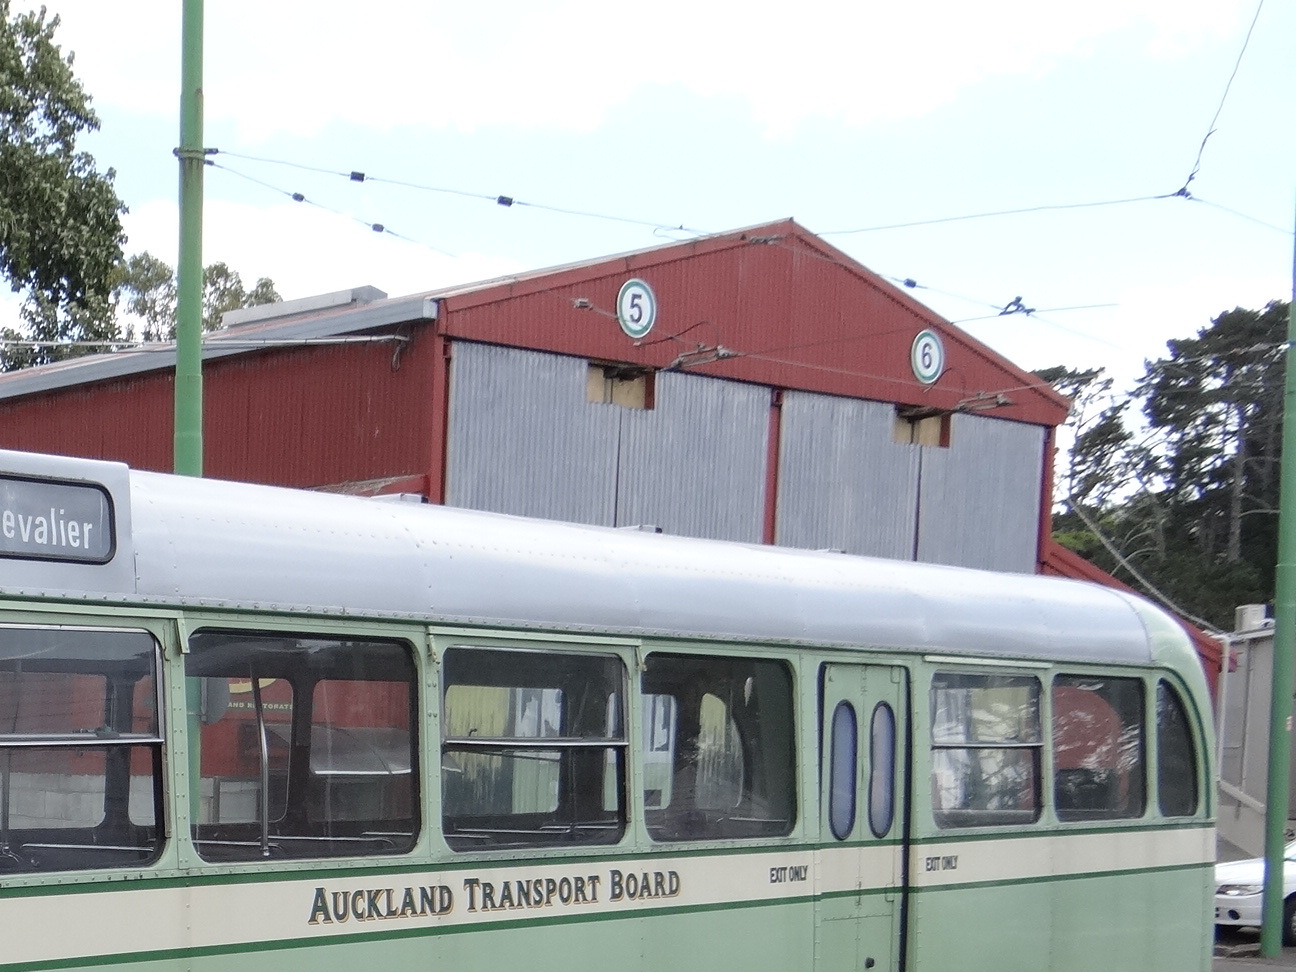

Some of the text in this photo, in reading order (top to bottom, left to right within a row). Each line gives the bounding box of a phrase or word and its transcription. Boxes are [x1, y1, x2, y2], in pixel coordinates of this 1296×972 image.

[629, 293, 643, 324] 5
[921, 342, 933, 370] 6
[770, 865, 808, 883] EXIT ONLY
[926, 856, 941, 871] EXIT
[308, 869, 681, 925] AUCKLAND TRANSPORT BOARD
